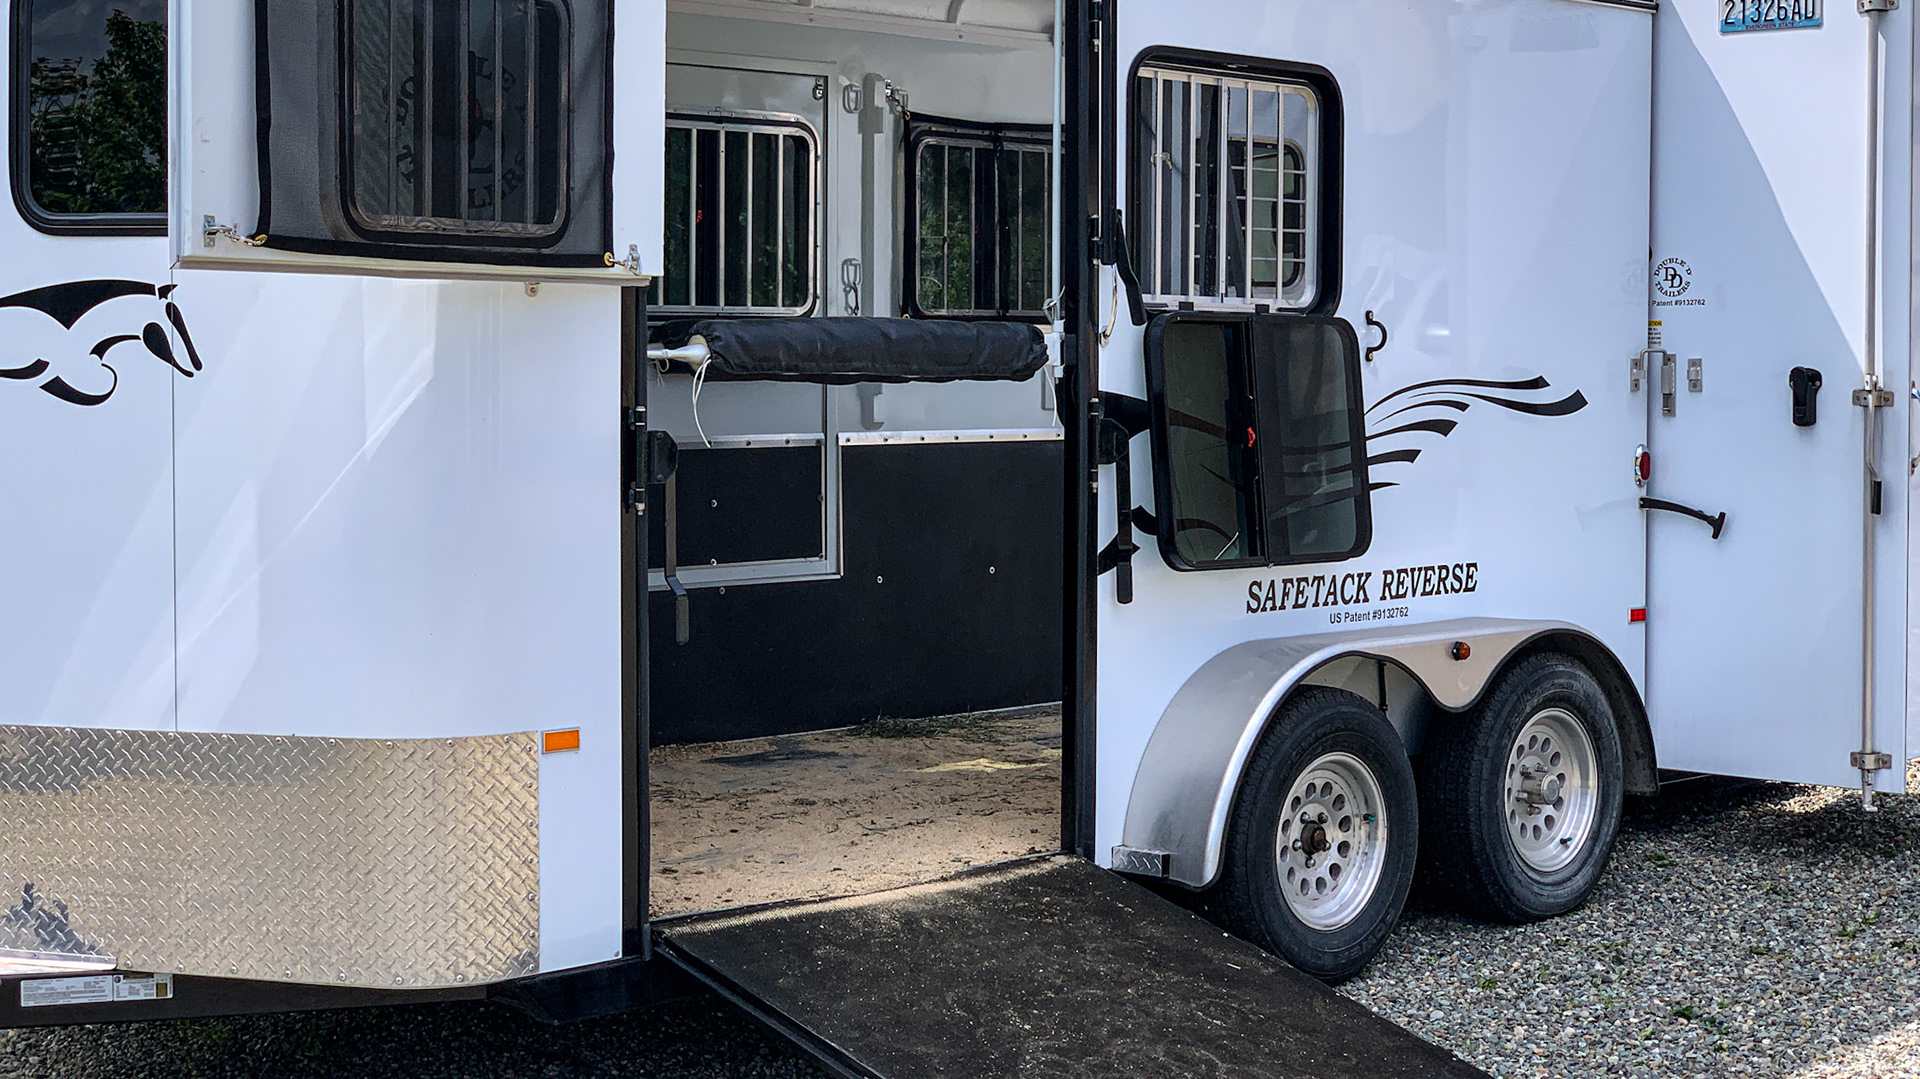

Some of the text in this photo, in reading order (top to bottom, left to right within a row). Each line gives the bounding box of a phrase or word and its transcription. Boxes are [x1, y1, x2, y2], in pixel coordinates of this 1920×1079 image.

[1654, 258, 1687, 276] DOUBLE
[1655, 281, 1690, 297] TRAILERS
[1246, 562, 1478, 614] SAFETACK REVERSE
[1329, 606, 1409, 624] US Patent #9132762
